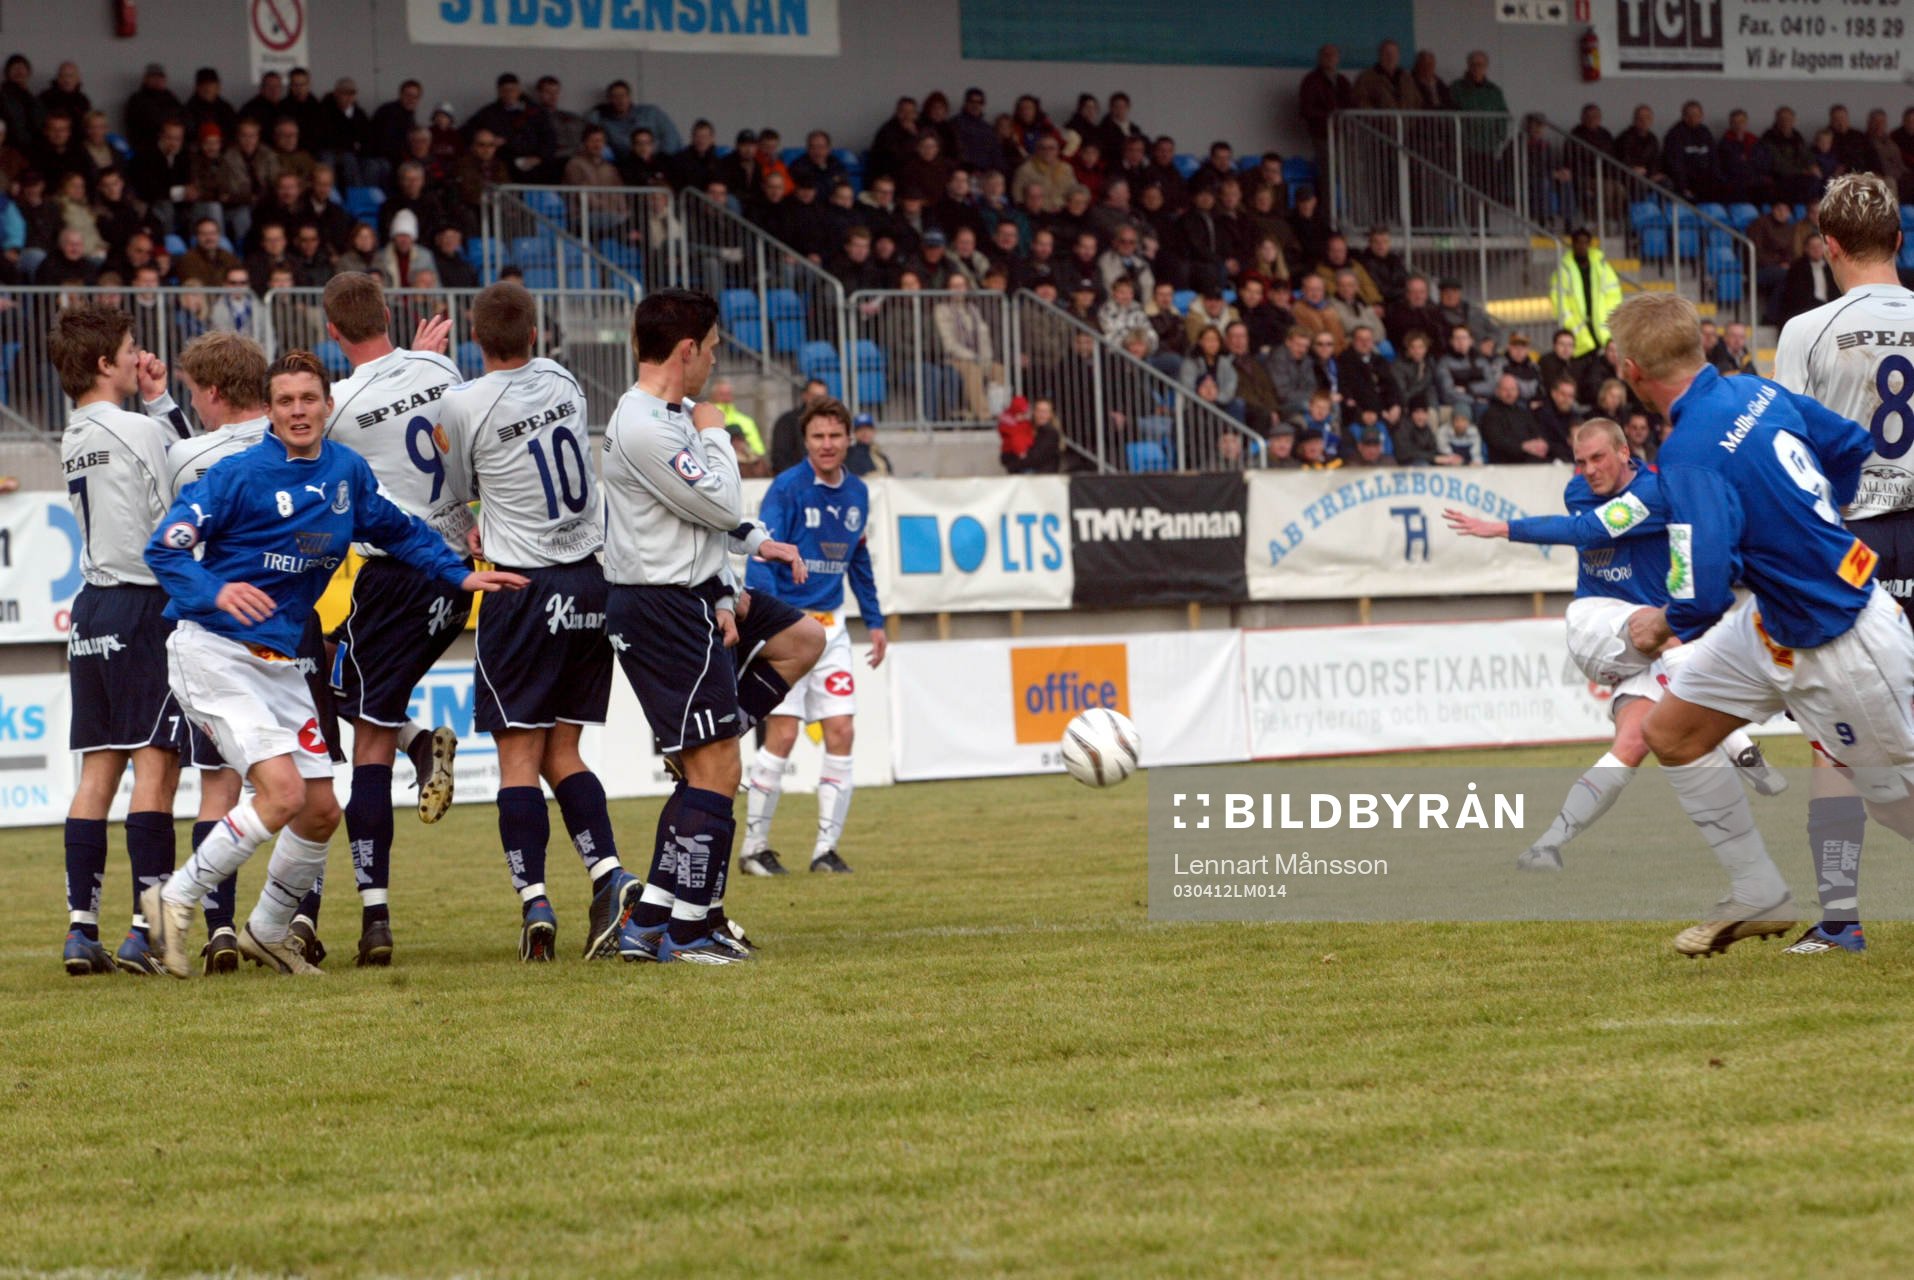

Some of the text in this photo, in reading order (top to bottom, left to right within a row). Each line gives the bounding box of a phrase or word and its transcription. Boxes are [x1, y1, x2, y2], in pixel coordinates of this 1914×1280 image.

[1738, 13, 1774, 35] Fax.
[1780, 14, 1826, 36] 0410
[1845, 17, 1876, 37] 195
[1881, 18, 1905, 38] 29
[1745, 46, 1761, 68] Vi
[1767, 47, 1786, 69] är
[1791, 48, 1843, 73] lagom
[1850, 50, 1900, 71] stora!
[372, 386, 443, 425] PEAB
[511, 402, 570, 437] PEAB
[1870, 354, 1914, 459] 8
[405, 415, 446, 504] 9
[527, 425, 589, 520] 10
[68, 476, 92, 560] 7
[275, 490, 294, 517] 8
[804, 507, 821, 528] 10
[170, 528, 193, 547] 13
[1000, 512, 1063, 572] LTS
[1267, 526, 1305, 568] AB
[1025, 672, 1117, 716] office
[1251, 653, 1554, 702] KONTORSFIXARNA
[168, 715, 180, 742] 7
[694, 708, 715, 739] 11
[1834, 721, 1856, 745] 9
